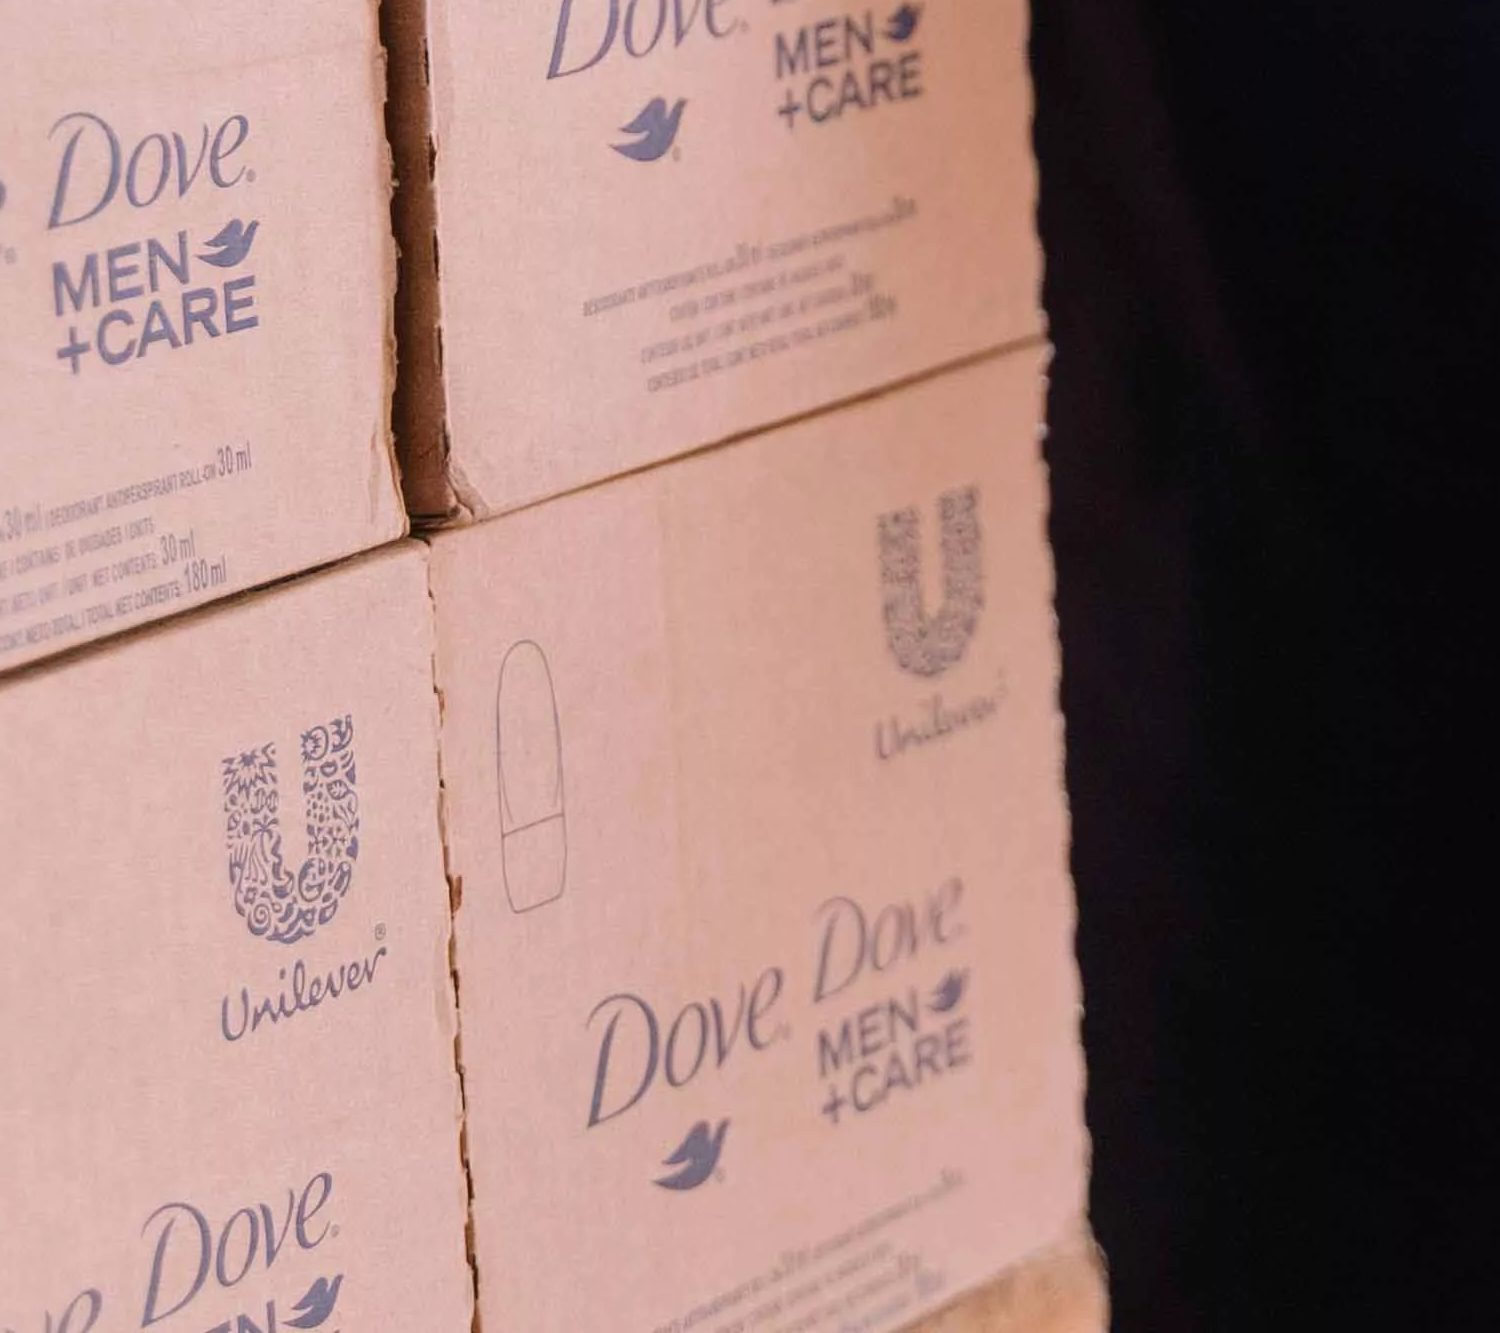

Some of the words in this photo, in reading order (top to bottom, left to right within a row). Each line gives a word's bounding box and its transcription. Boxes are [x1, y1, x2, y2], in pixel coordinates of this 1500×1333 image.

[774, 7, 875, 79] MEN
[777, 52, 923, 130] +CARE
[47, 112, 251, 230] Dove
[51, 230, 190, 317] MEN
[56, 275, 260, 375] +CARE
[217, 444, 234, 478] 30
[236, 440, 253, 472] ml
[159, 531, 178, 566] 30
[180, 528, 197, 561] ml
[184, 558, 209, 594] 180
[210, 554, 228, 587] ml
[813, 876, 964, 1005] Dove
[221, 947, 388, 1042] Unilever
[816, 987, 920, 1079] MEN
[586, 965, 783, 1129] Dove
[823, 1018, 972, 1125] +CARE
[140, 1171, 334, 1328] Dove
